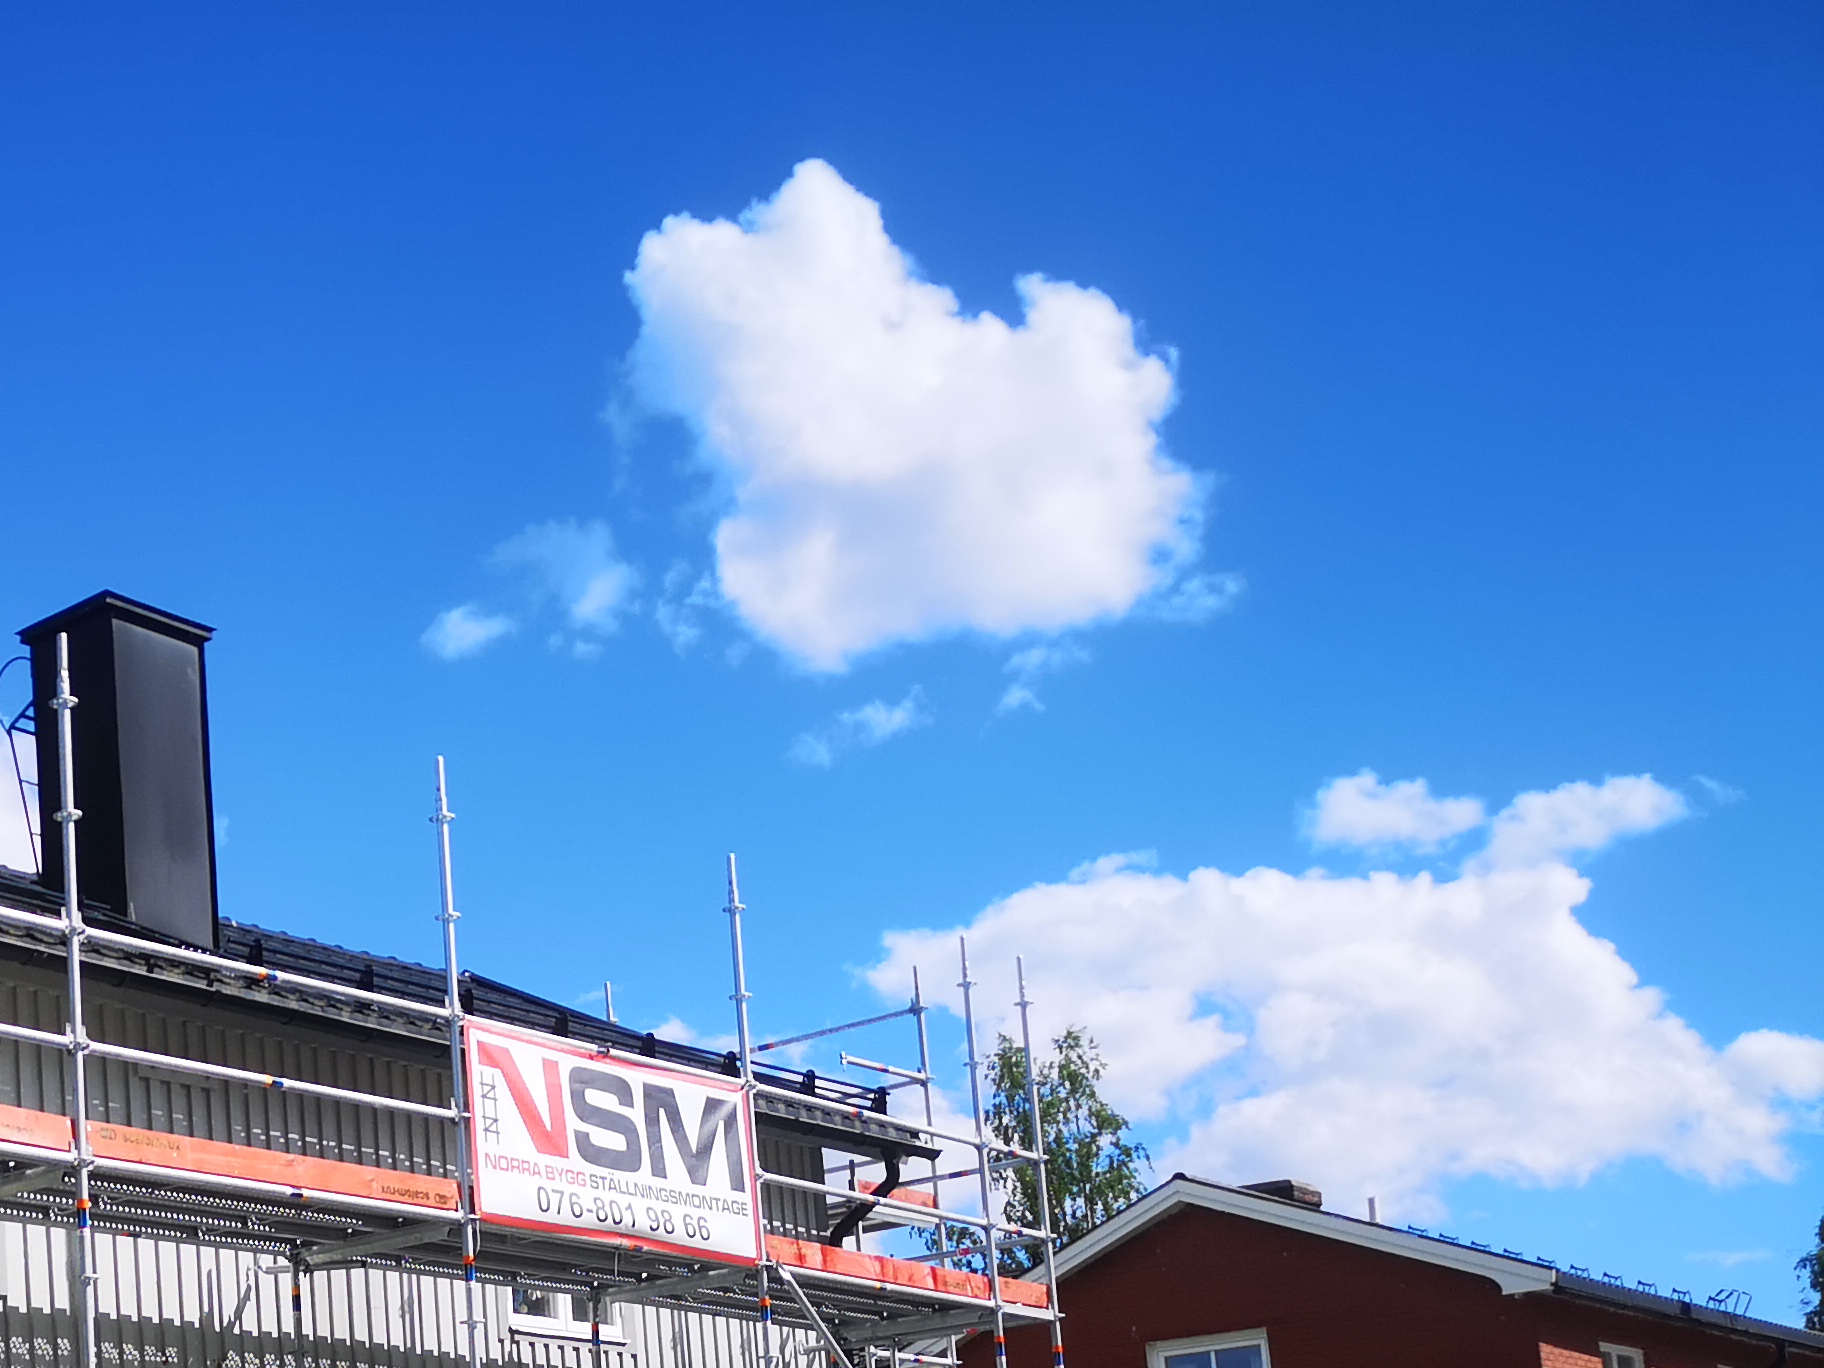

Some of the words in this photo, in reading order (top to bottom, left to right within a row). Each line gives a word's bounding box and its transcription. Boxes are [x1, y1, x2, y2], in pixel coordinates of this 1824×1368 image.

[477, 1040, 746, 1193] NSM
[485, 1152, 542, 1179] NORRA
[545, 1164, 587, 1187] BYGG
[589, 1172, 749, 1217] STÄLLNINGSMONTAGE
[537, 1186, 637, 1228] 076-801
[646, 1206, 675, 1235] 98
[683, 1213, 711, 1241] 66
